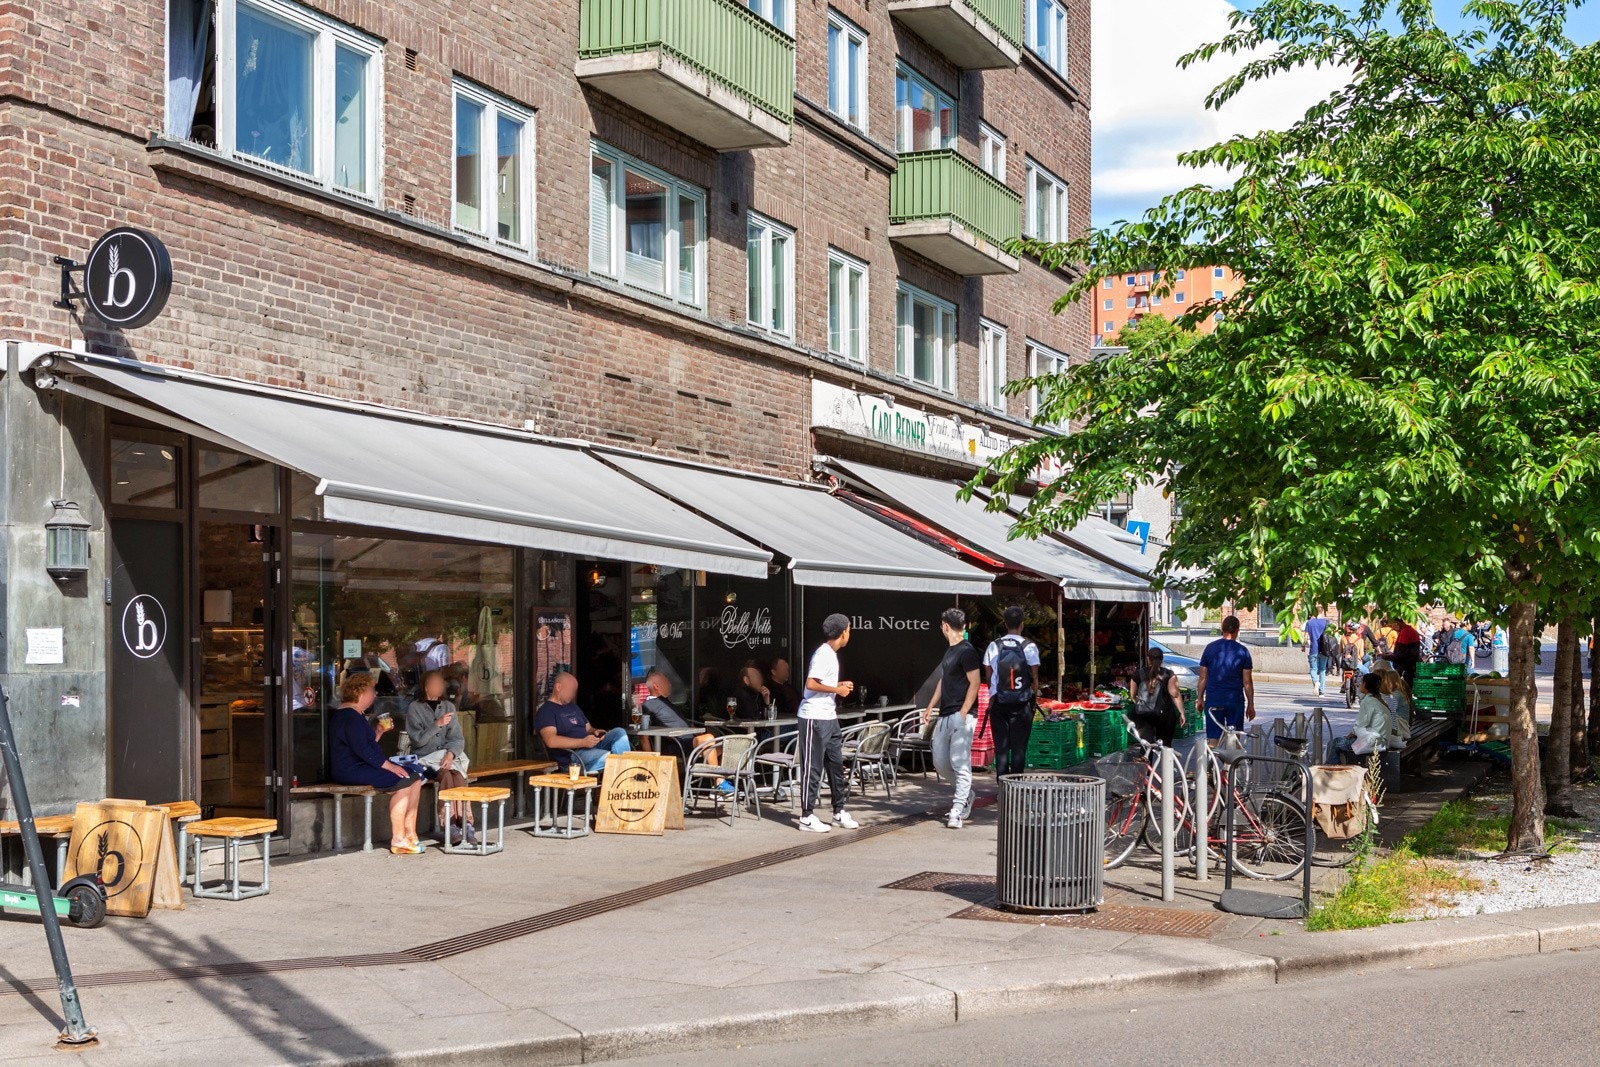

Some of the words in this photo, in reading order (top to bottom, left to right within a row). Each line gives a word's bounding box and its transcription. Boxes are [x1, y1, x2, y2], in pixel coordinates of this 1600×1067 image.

[102, 244, 136, 308] b
[872, 405, 892, 442] CARL
[895, 411, 926, 449] BERNER
[135, 601, 158, 651] b
[720, 605, 750, 640] Bella
[878, 616, 930, 630] Notte
[607, 788, 660, 801] backstube
